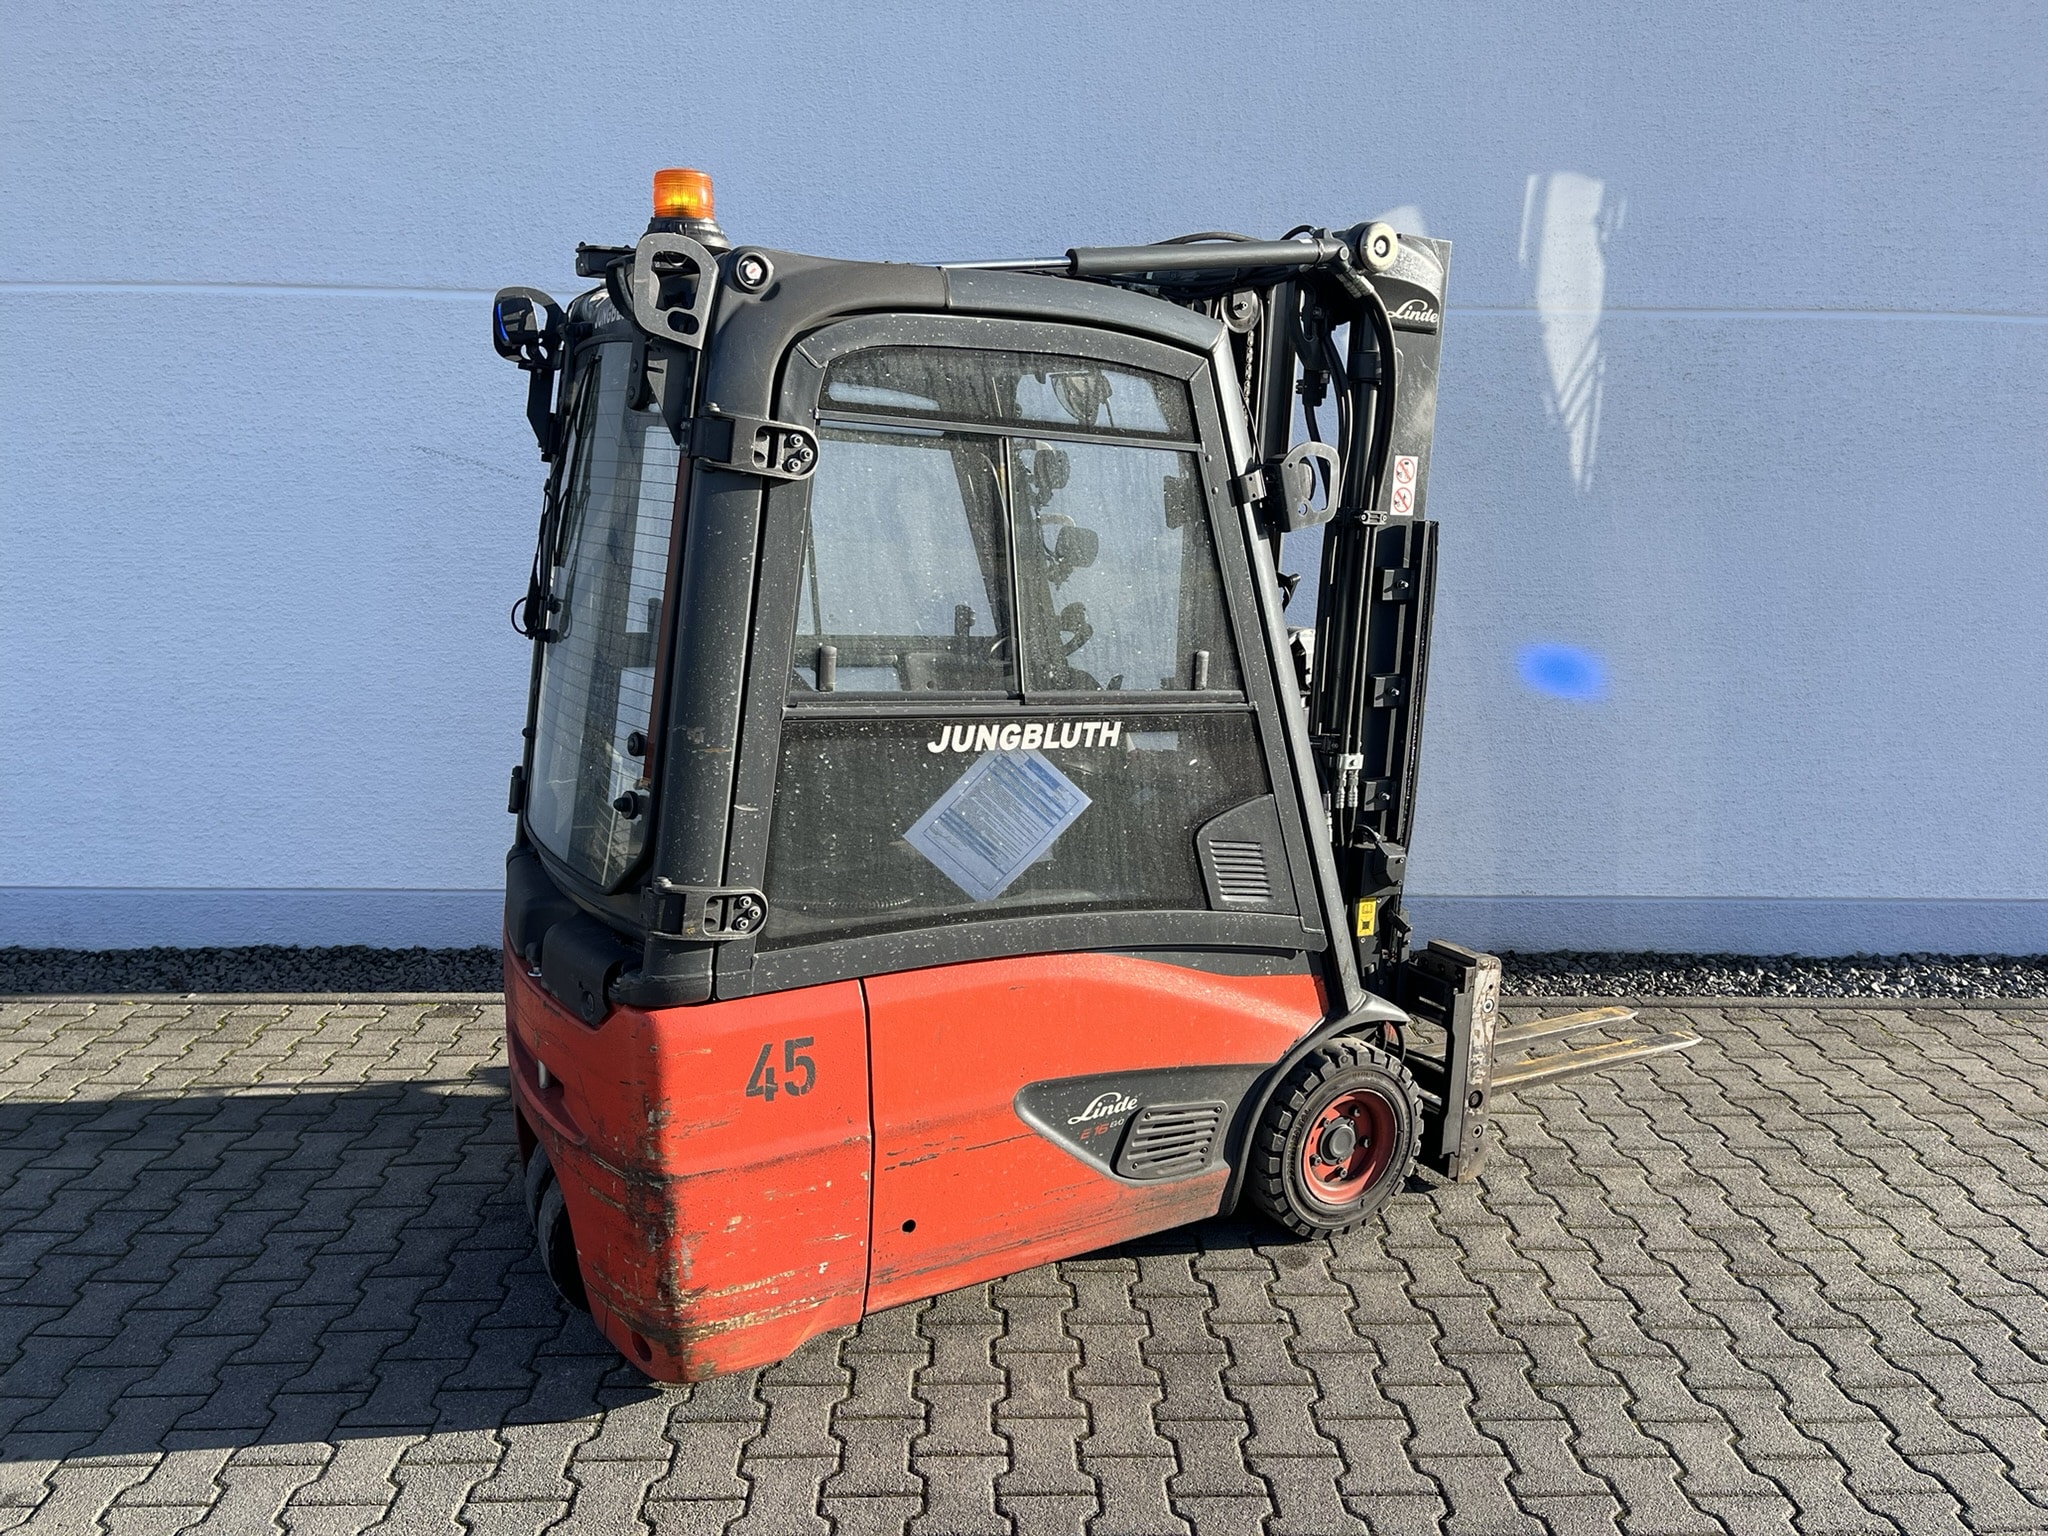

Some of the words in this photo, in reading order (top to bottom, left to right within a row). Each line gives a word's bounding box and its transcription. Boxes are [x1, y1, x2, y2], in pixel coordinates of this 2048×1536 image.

[1386, 299, 1438, 323] Linde
[927, 721, 1122, 753] JUNGBLUTH
[746, 1036, 816, 1102] 45
[1067, 1091, 1138, 1125] Linde
